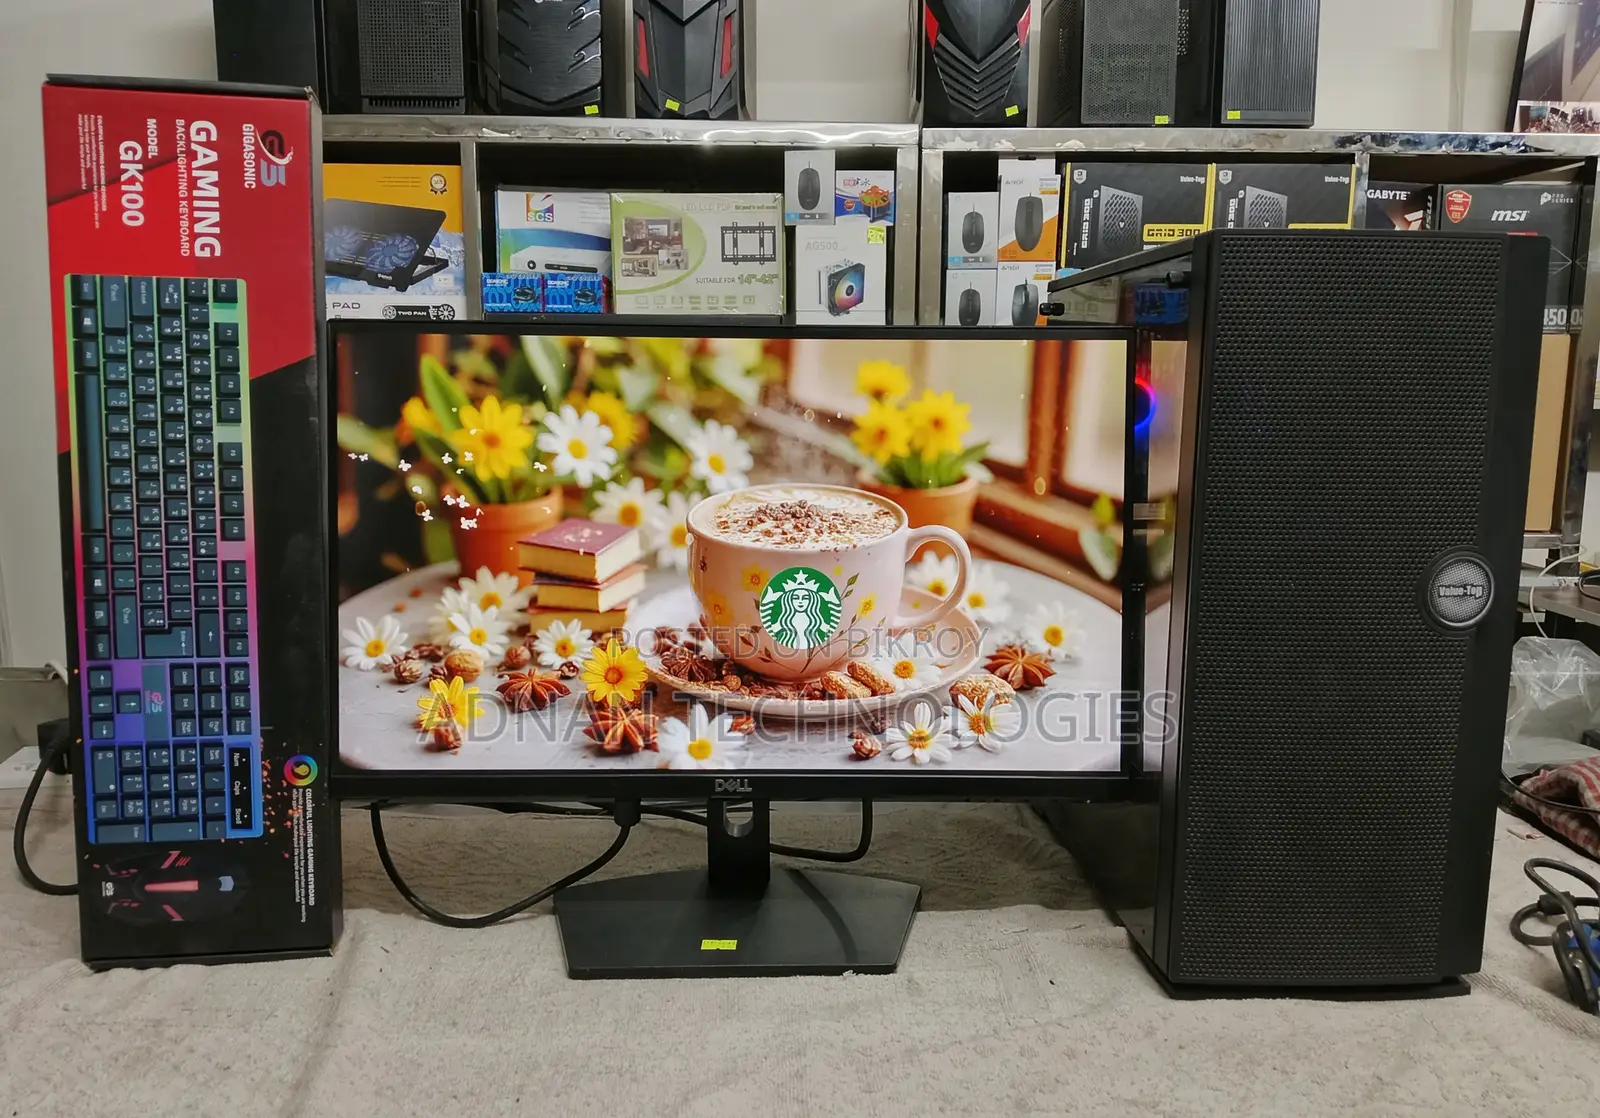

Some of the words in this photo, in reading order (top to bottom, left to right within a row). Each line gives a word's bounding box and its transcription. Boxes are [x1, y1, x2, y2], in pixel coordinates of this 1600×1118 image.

[146, 118, 158, 158] MODEL
[176, 118, 188, 198] BACKLIGHTING
[242, 124, 256, 188] GIGASONIC
[119, 140, 145, 227] GK100
[190, 120, 222, 258] GAMING
[179, 200, 190, 256] KEYBOARD
[527, 212, 554, 222] SCS
[1490, 210, 1526, 221] msi
[805, 240, 838, 251] AG500
[1147, 228, 1175, 237] GRID
[1439, 586, 1482, 598] Value-Top
[714, 779, 752, 792] DELL
